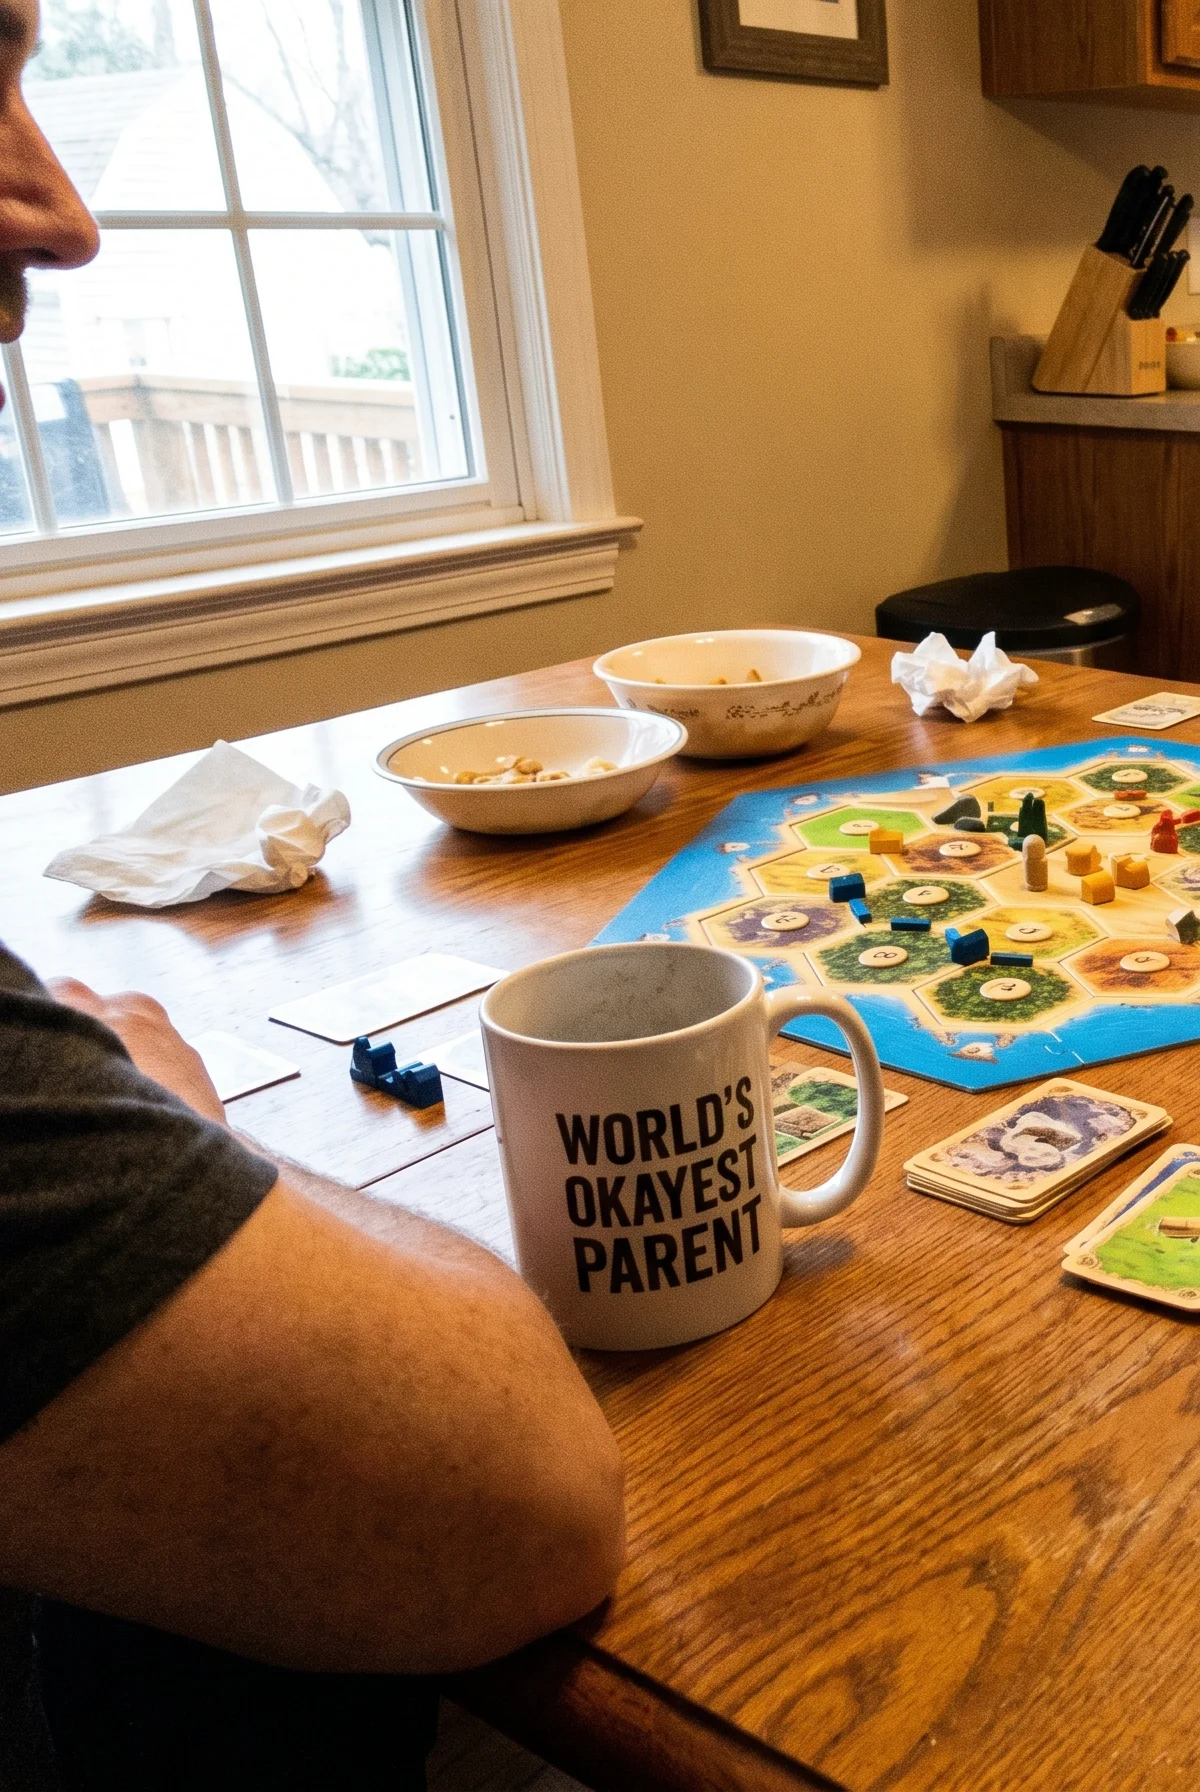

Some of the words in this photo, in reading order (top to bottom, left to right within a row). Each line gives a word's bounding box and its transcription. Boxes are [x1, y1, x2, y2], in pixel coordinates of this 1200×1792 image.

[555, 1076, 754, 1167] WORLD'S
[564, 1134, 757, 1228] OKAYEST
[573, 1194, 762, 1294] PARENT
